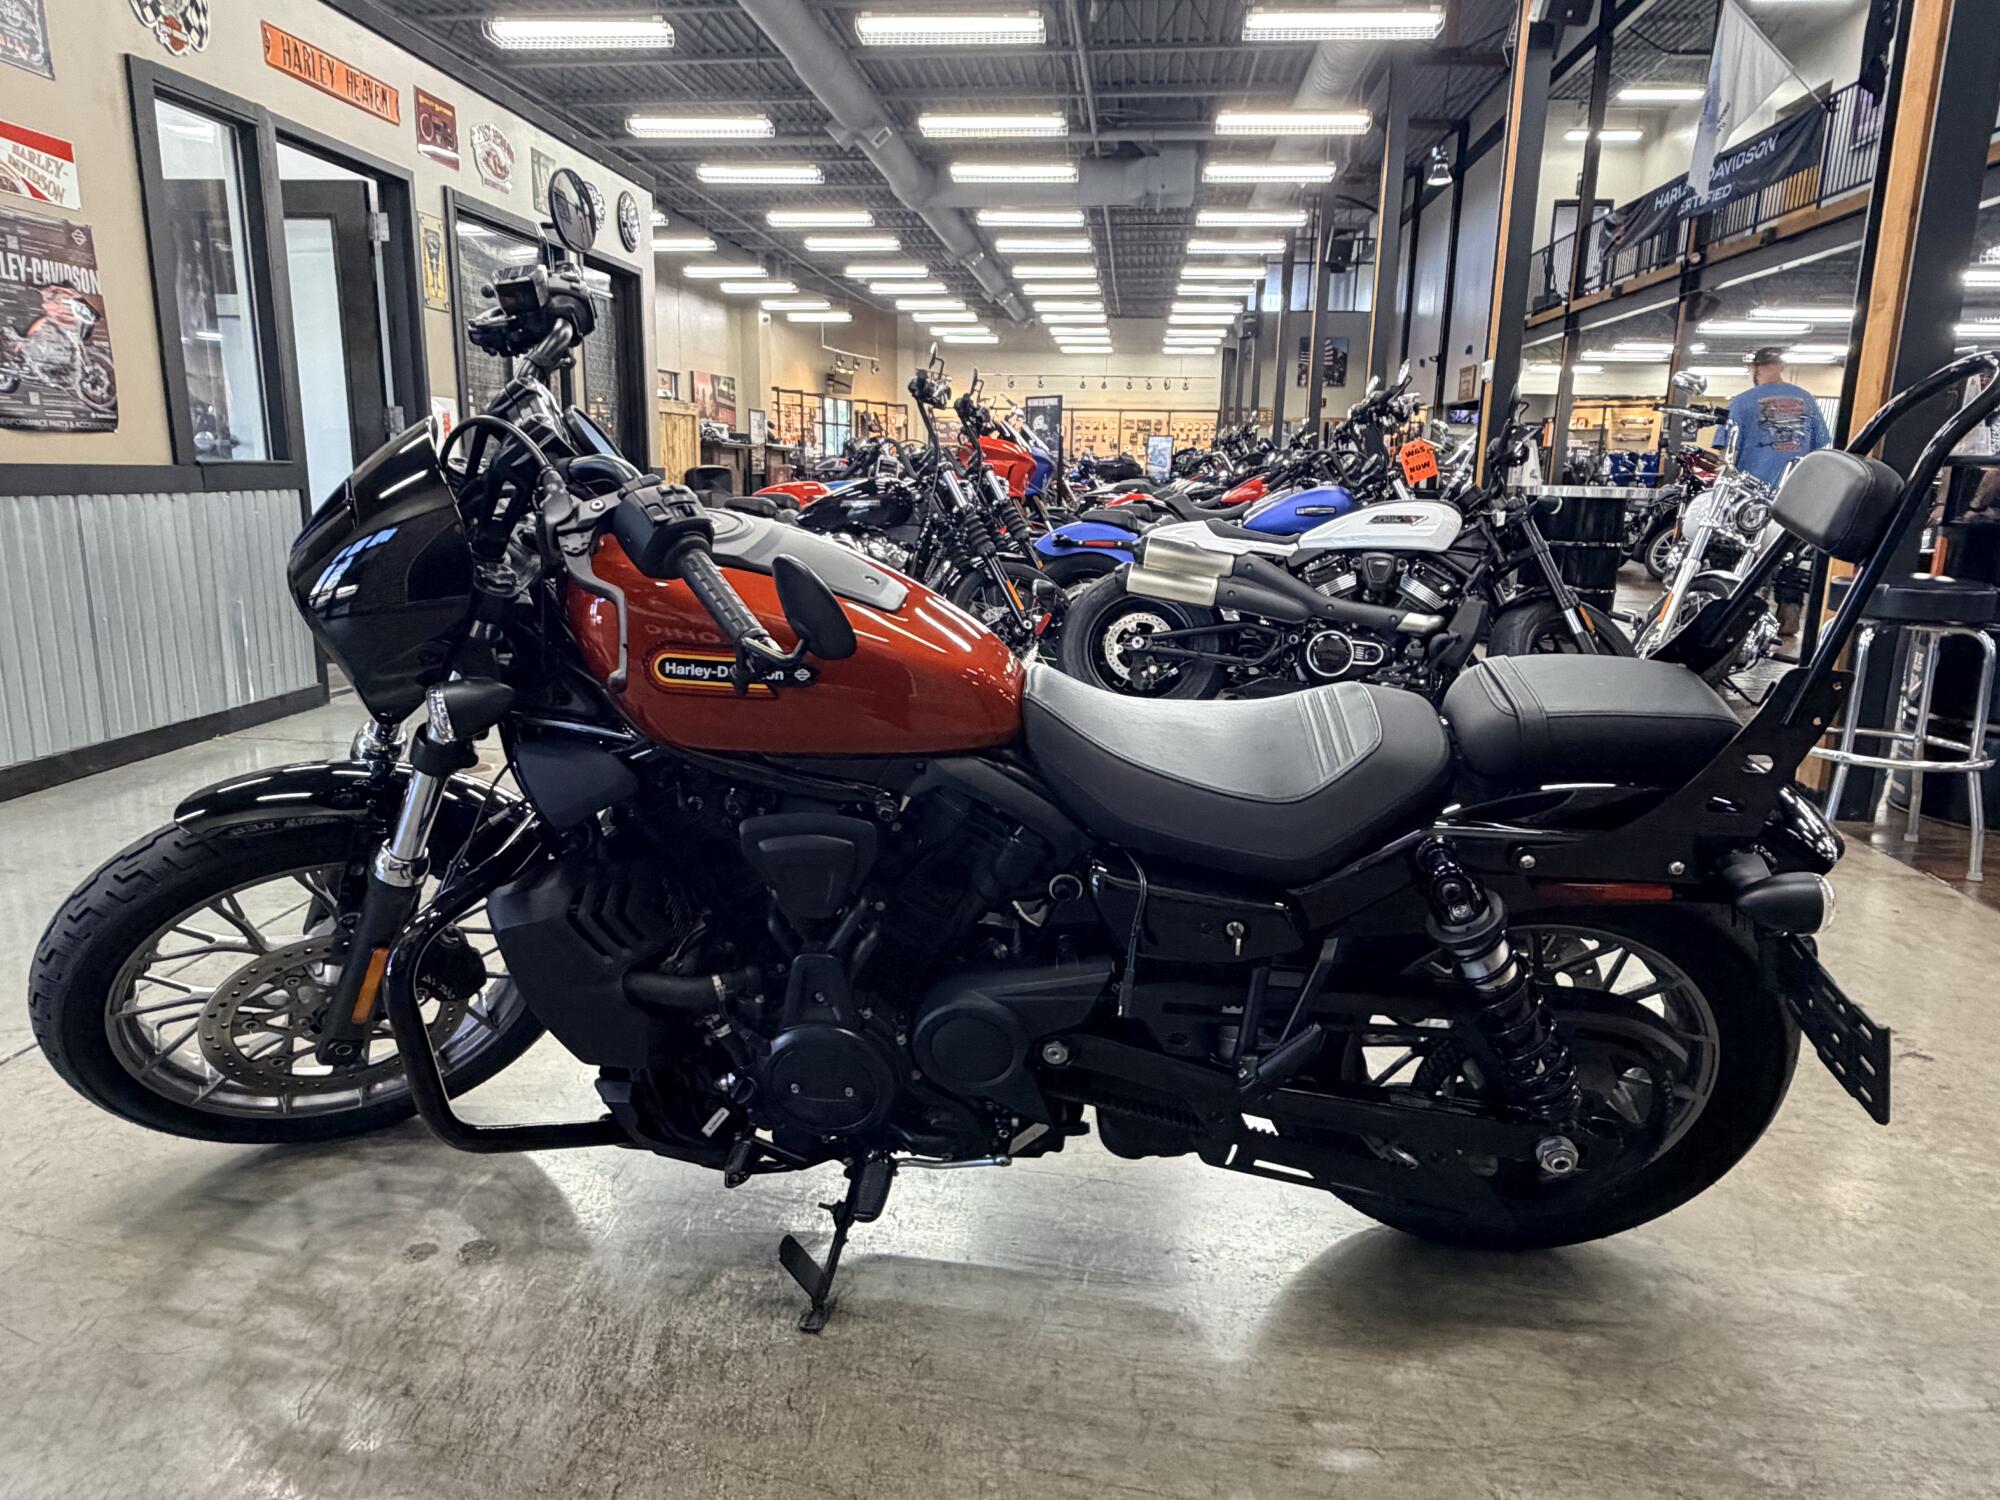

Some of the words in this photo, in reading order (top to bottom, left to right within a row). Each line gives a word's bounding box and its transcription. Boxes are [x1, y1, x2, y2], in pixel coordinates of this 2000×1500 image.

[280, 34, 335, 89] HARLEY
[344, 67, 390, 117] HEAVEN
[8, 153, 66, 205] DAVIDSON
[1405, 445, 1426, 458] WAS
[1409, 461, 1430, 473] NOW
